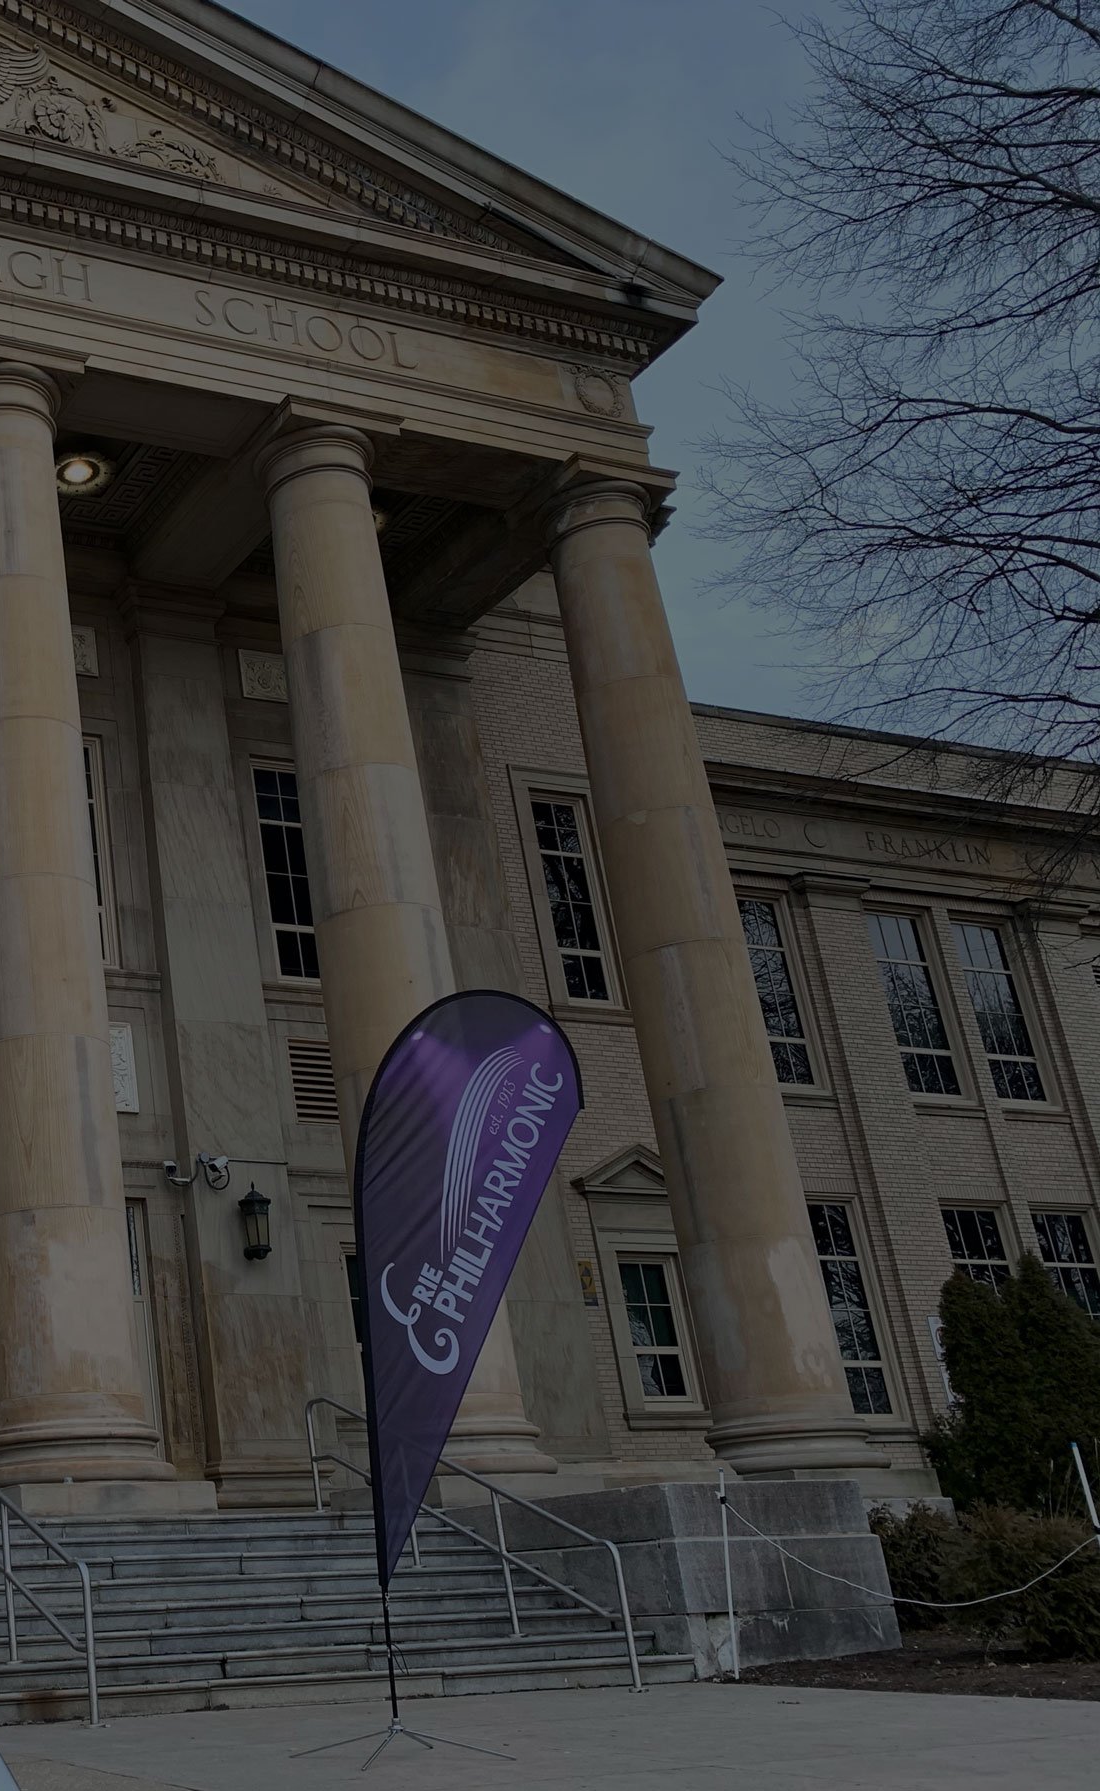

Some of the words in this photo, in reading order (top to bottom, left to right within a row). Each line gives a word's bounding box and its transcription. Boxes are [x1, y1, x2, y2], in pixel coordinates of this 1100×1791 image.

[194, 290, 419, 370] SCHOOL
[865, 831, 991, 865] FRANKLIN
[488, 1113, 504, 1136] est.
[497, 1080, 516, 1110] 1913
[433, 1062, 564, 1324] PHILHARMONIC
